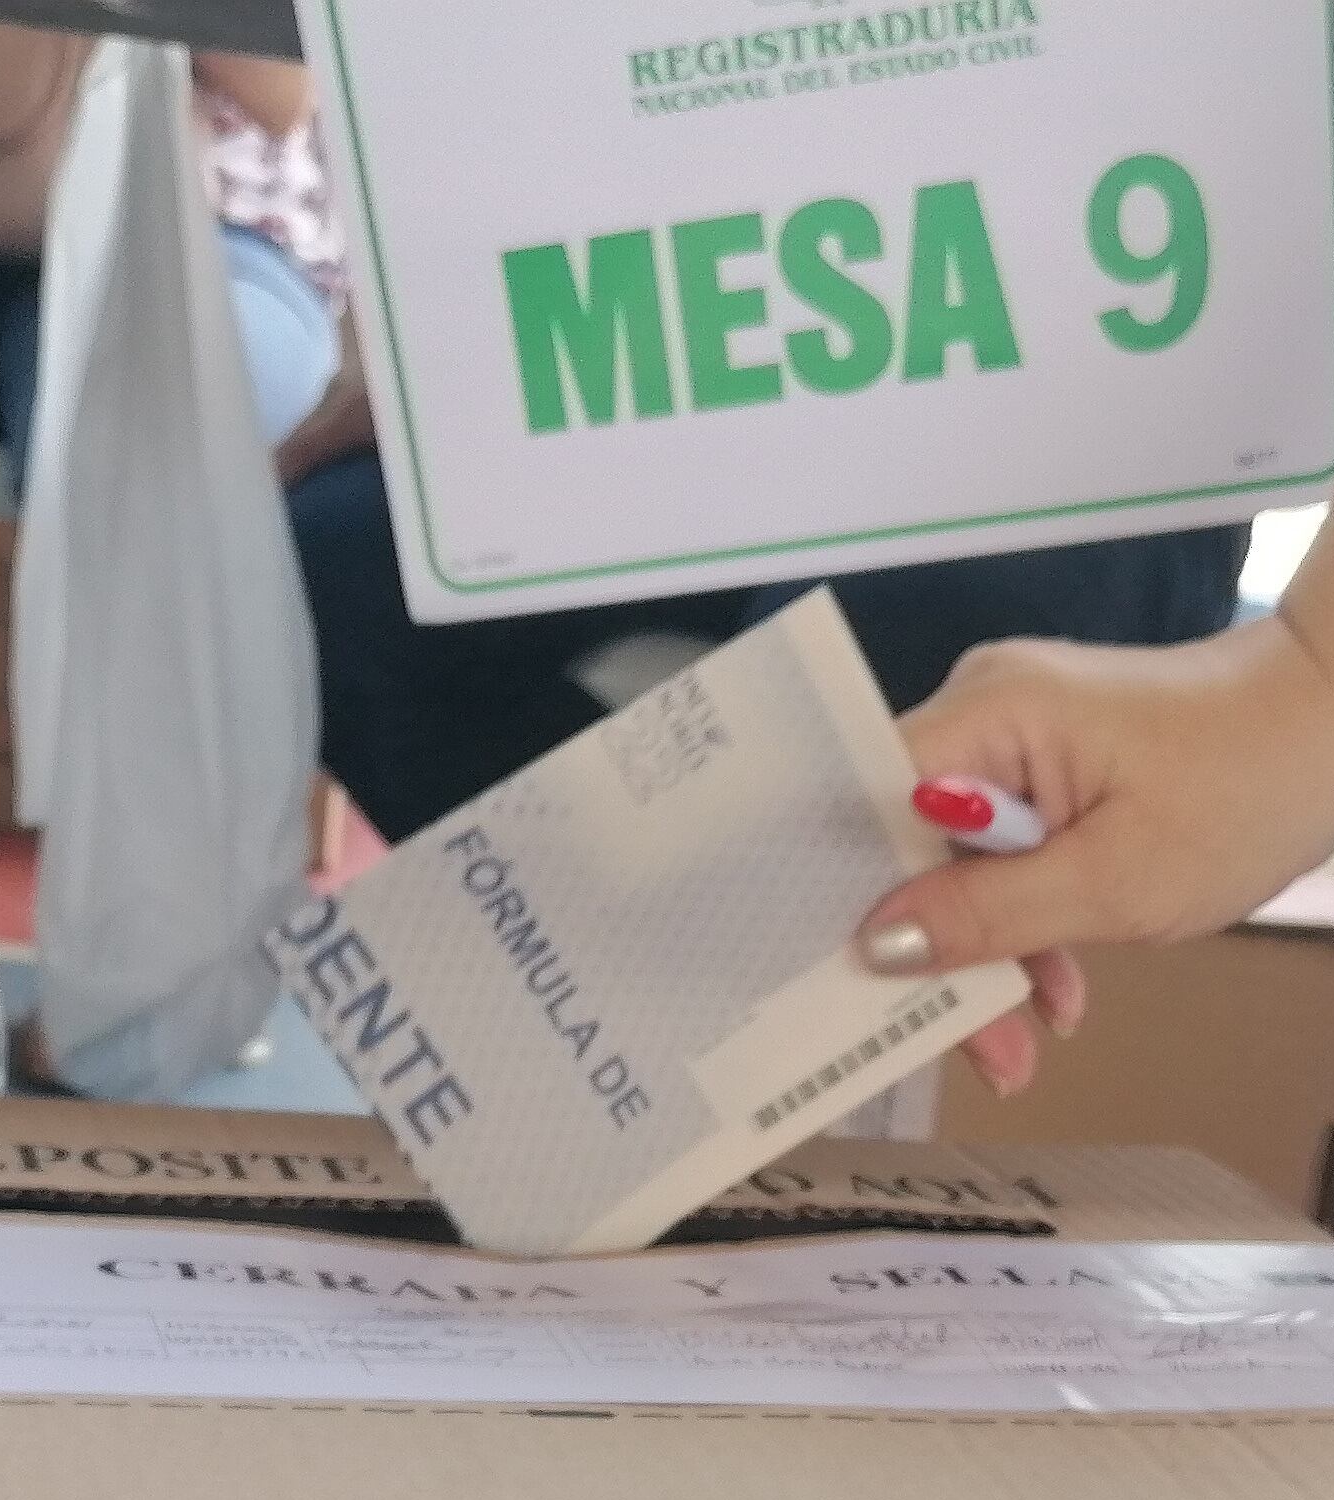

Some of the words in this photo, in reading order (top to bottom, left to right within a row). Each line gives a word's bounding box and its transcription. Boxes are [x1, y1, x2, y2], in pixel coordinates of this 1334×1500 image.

[632, 79, 769, 117] NACIONAL
[781, 68, 836, 94] DEL
[847, 49, 959, 83] ESTADO
[967, 35, 1040, 66] CIVIL
[501, 180, 1022, 435] MESA
[1086, 153, 1211, 353] 9
[442, 825, 602, 1062] FÓRMULA
[588, 1053, 653, 1132] DE
[677, 1276, 730, 1299] Y
